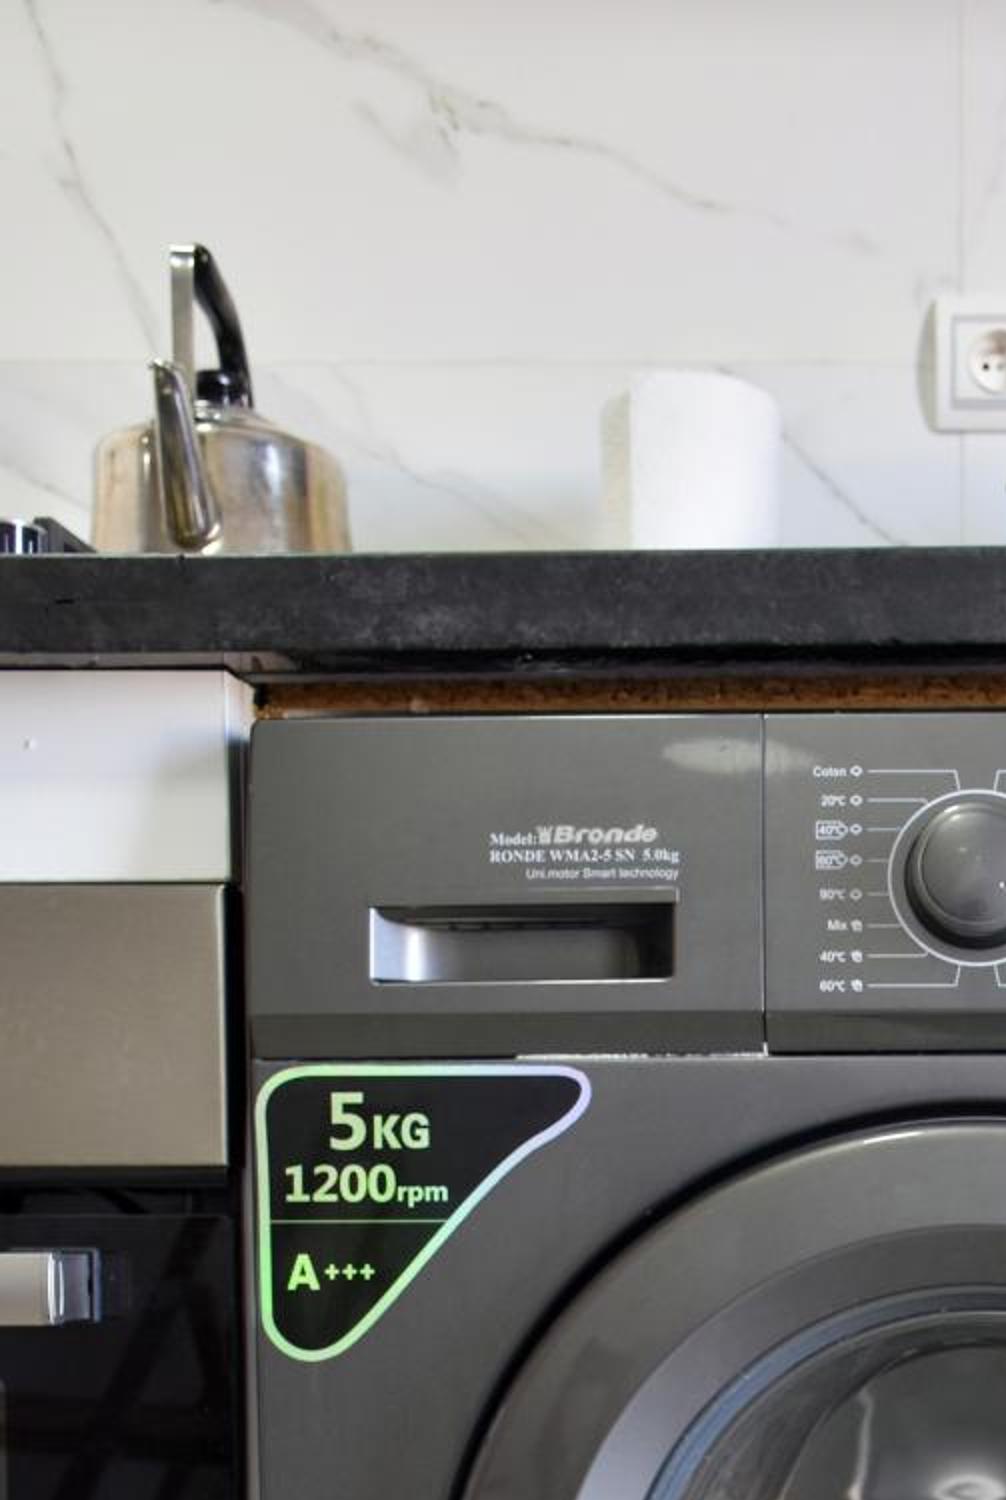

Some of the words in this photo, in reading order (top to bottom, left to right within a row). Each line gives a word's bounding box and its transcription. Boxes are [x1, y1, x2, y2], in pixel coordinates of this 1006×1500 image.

[489, 849, 546, 865] RONDE
[583, 867, 617, 880] Smart
[618, 866, 679, 881] technology
